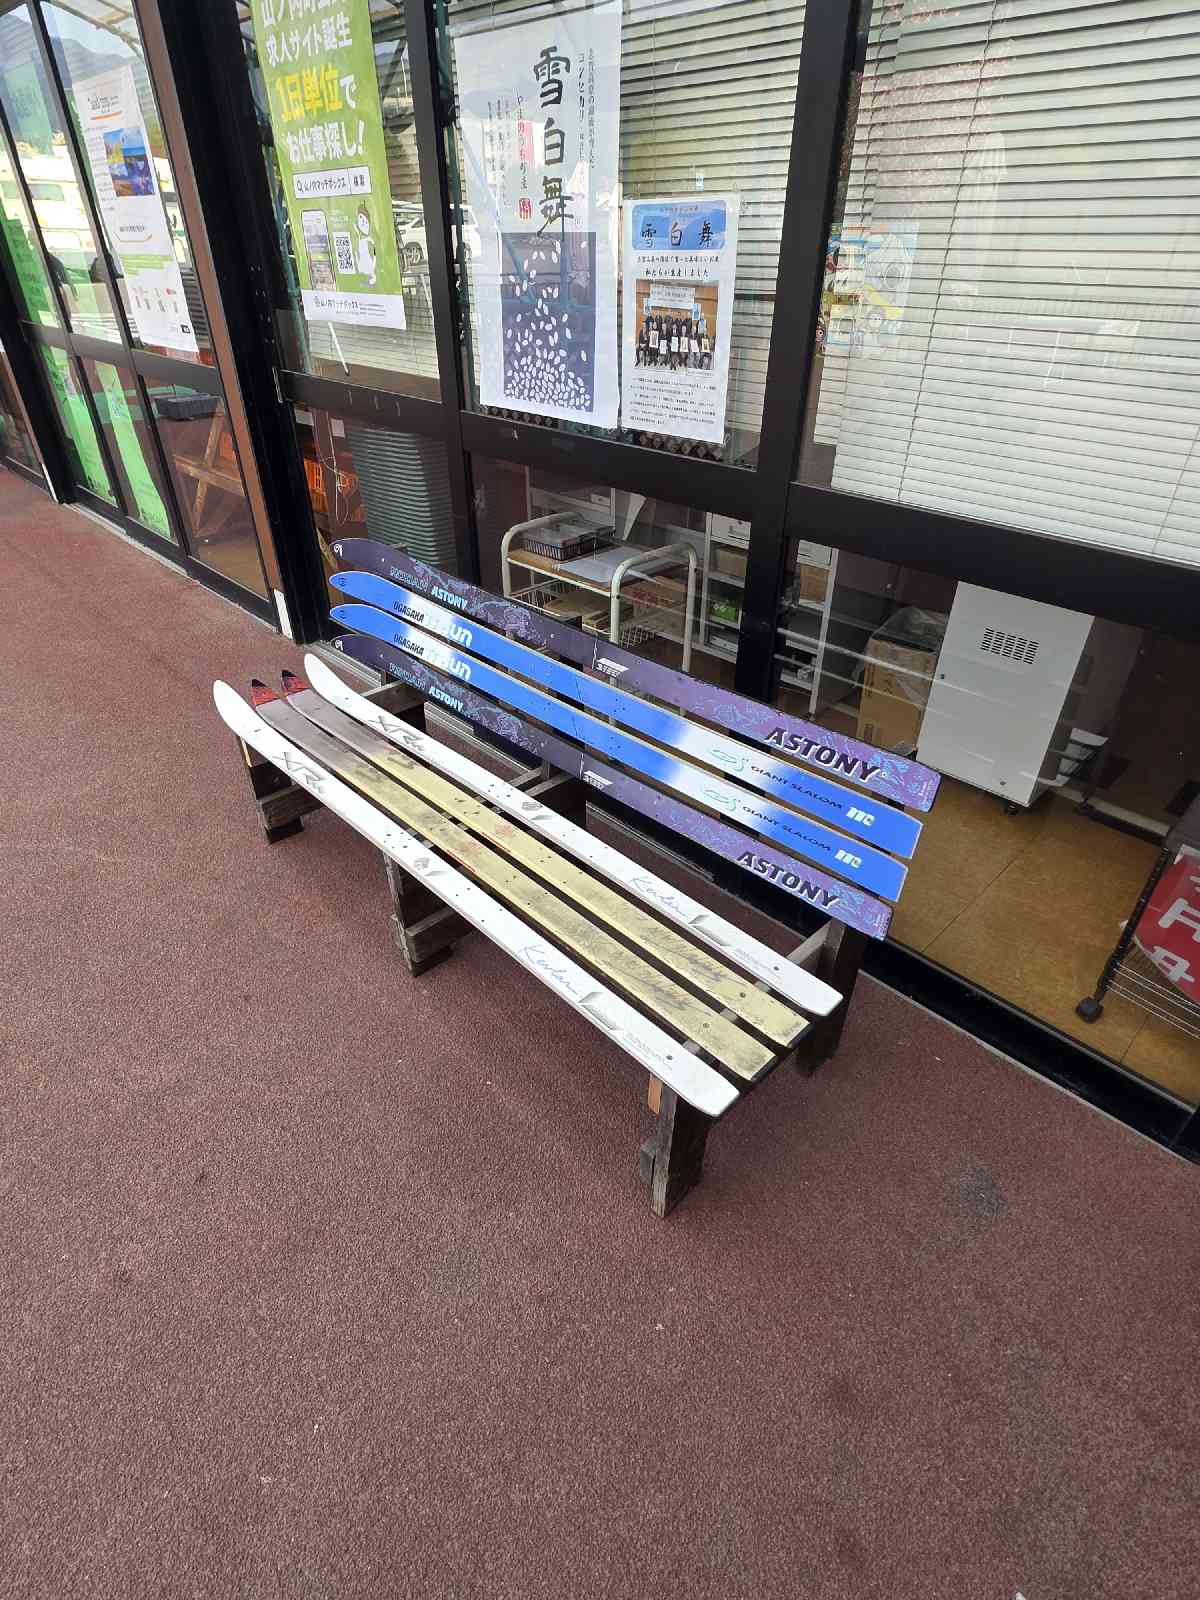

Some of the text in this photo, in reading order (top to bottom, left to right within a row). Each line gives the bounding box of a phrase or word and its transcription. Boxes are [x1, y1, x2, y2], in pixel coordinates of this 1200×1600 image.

[266, 11, 353, 67] 求人サイト誕生
[276, 63, 357, 122] 1日単位で
[533, 46, 575, 242] 雪白舞
[641, 220, 714, 248] 雪白舞
[393, 600, 425, 624] OGASAKA
[431, 585, 468, 611] ASTONY
[393, 632, 425, 657] OGASAKA
[428, 686, 465, 713] ASTONY
[764, 727, 881, 783] ASTONY
[751, 765, 842, 809] GIANT SLALOM
[742, 805, 832, 852] GIANT SLALOM
[736, 851, 840, 910] ASTONY
